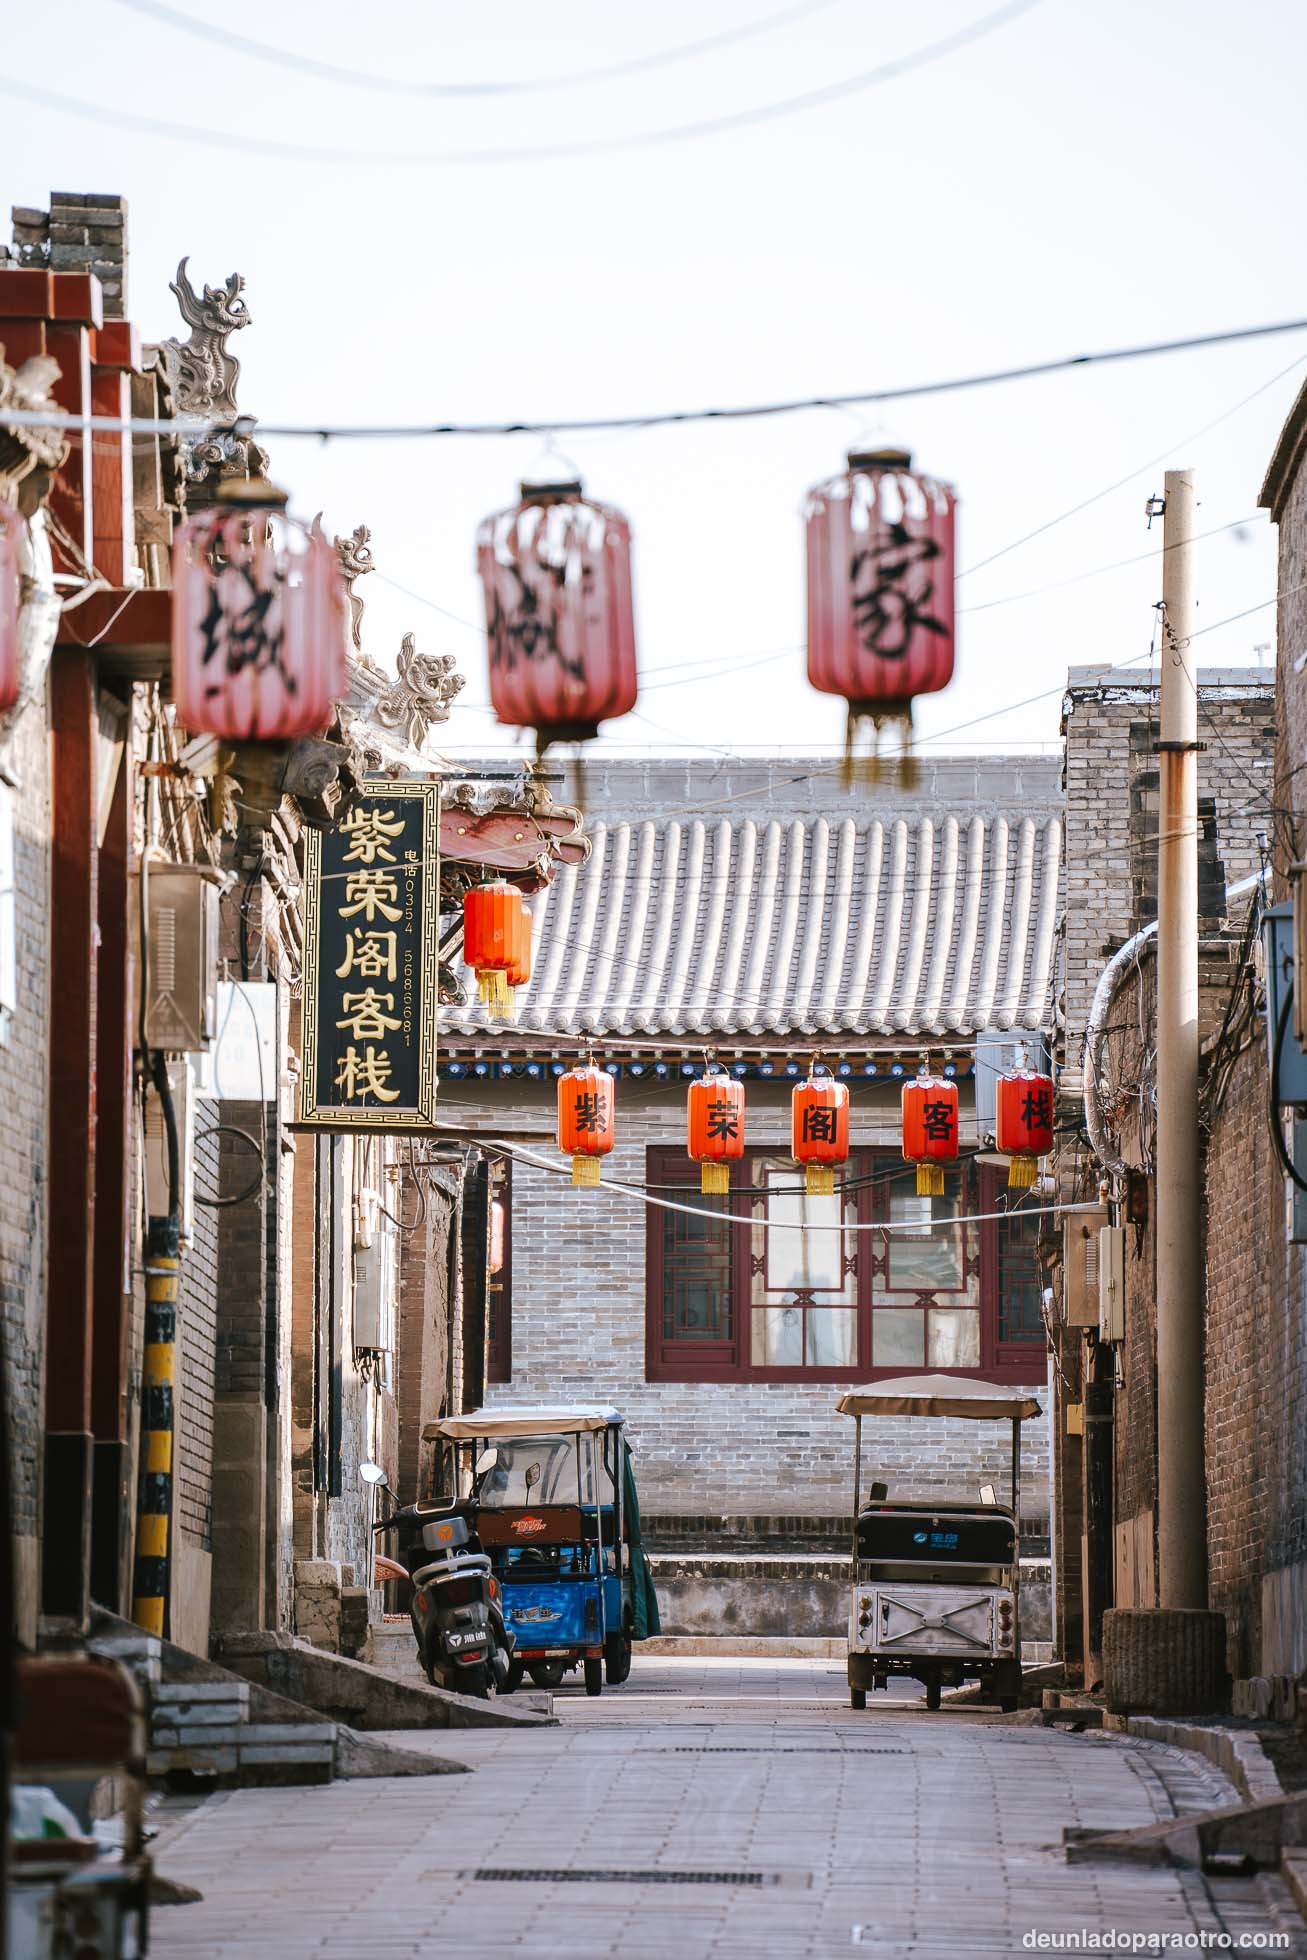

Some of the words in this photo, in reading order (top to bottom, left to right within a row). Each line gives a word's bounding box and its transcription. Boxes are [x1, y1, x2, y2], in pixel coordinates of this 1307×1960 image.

[334, 807, 406, 1102] 紫荣阁客栈
[574, 1092, 607, 1133] 紫
[706, 1099, 739, 1141] 荣
[802, 1103, 838, 1144] 阁
[922, 1100, 954, 1142] 客
[1020, 1090, 1051, 1131] 栈
